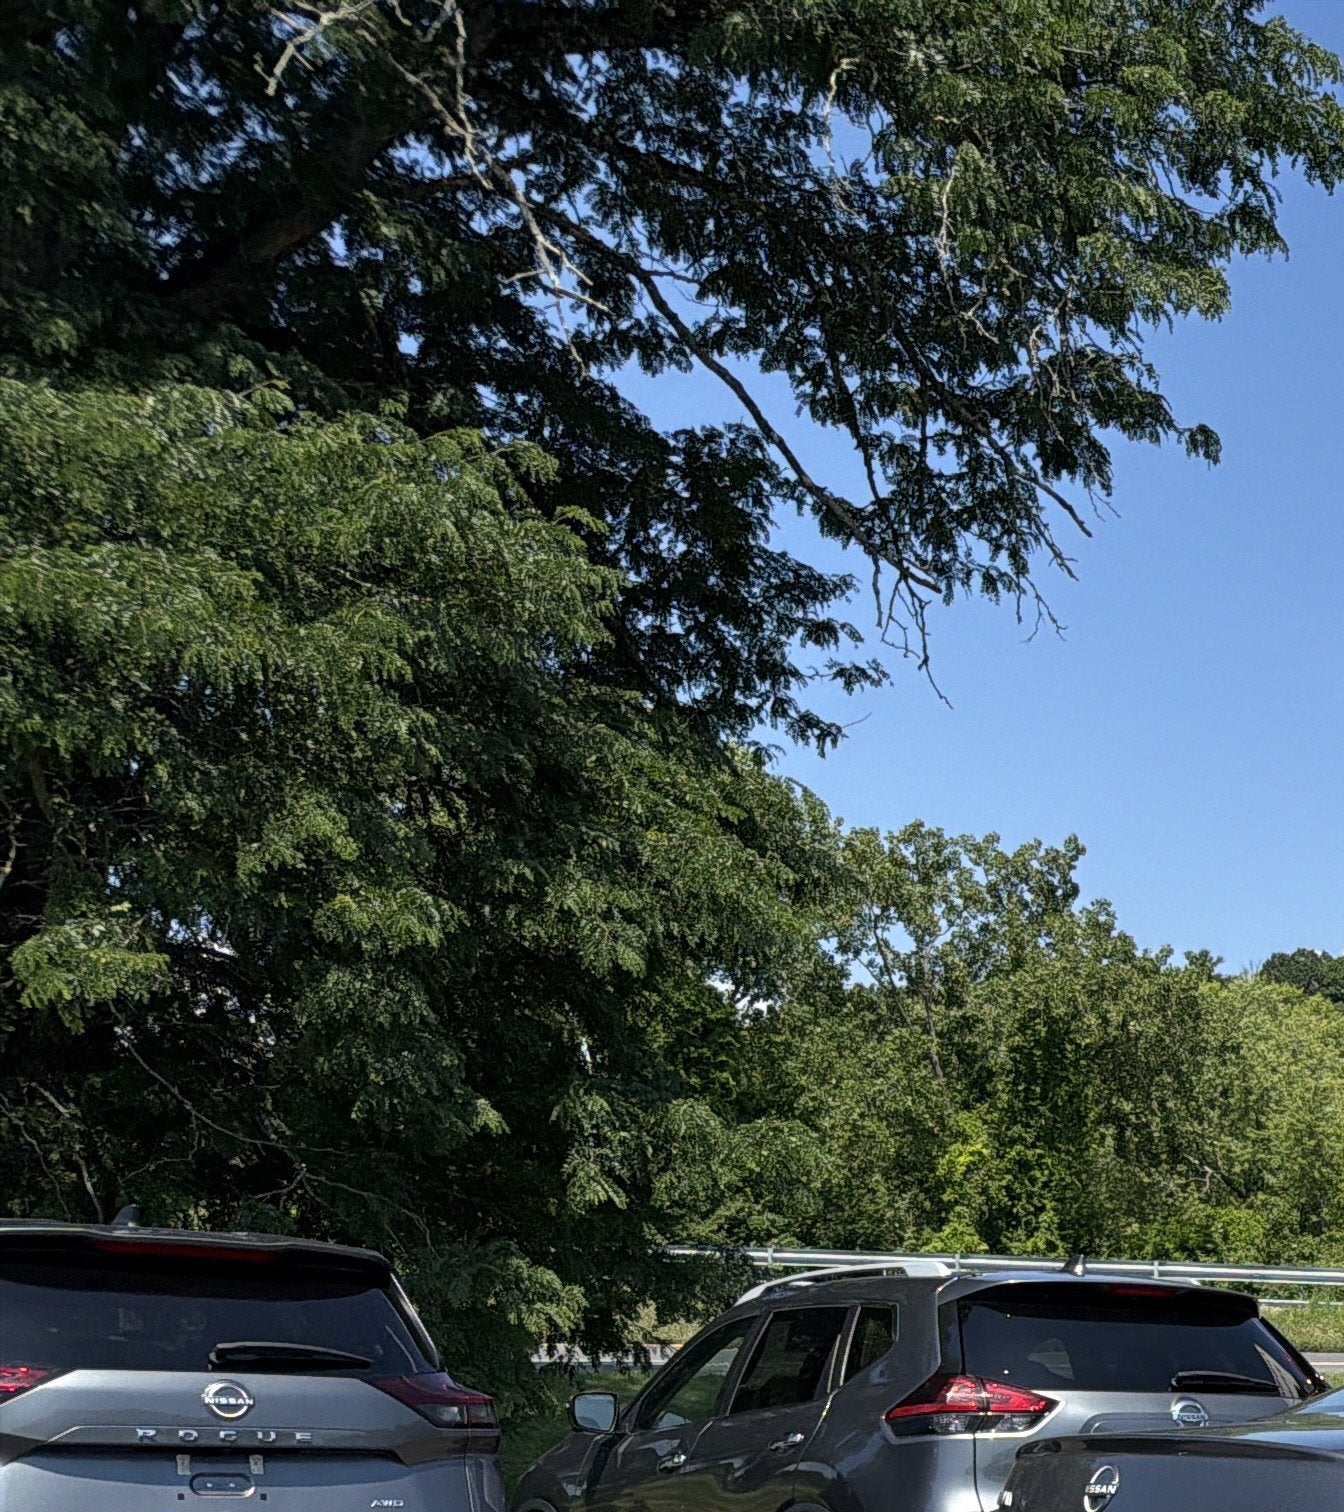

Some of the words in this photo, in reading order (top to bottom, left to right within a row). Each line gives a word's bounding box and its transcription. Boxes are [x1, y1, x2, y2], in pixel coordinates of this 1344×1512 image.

[204, 1397, 254, 1405] NISSAN
[136, 1428, 313, 1442] ROGUE
[1084, 1484, 1117, 1495] ISSAN
[370, 1499, 404, 1508] AWD
